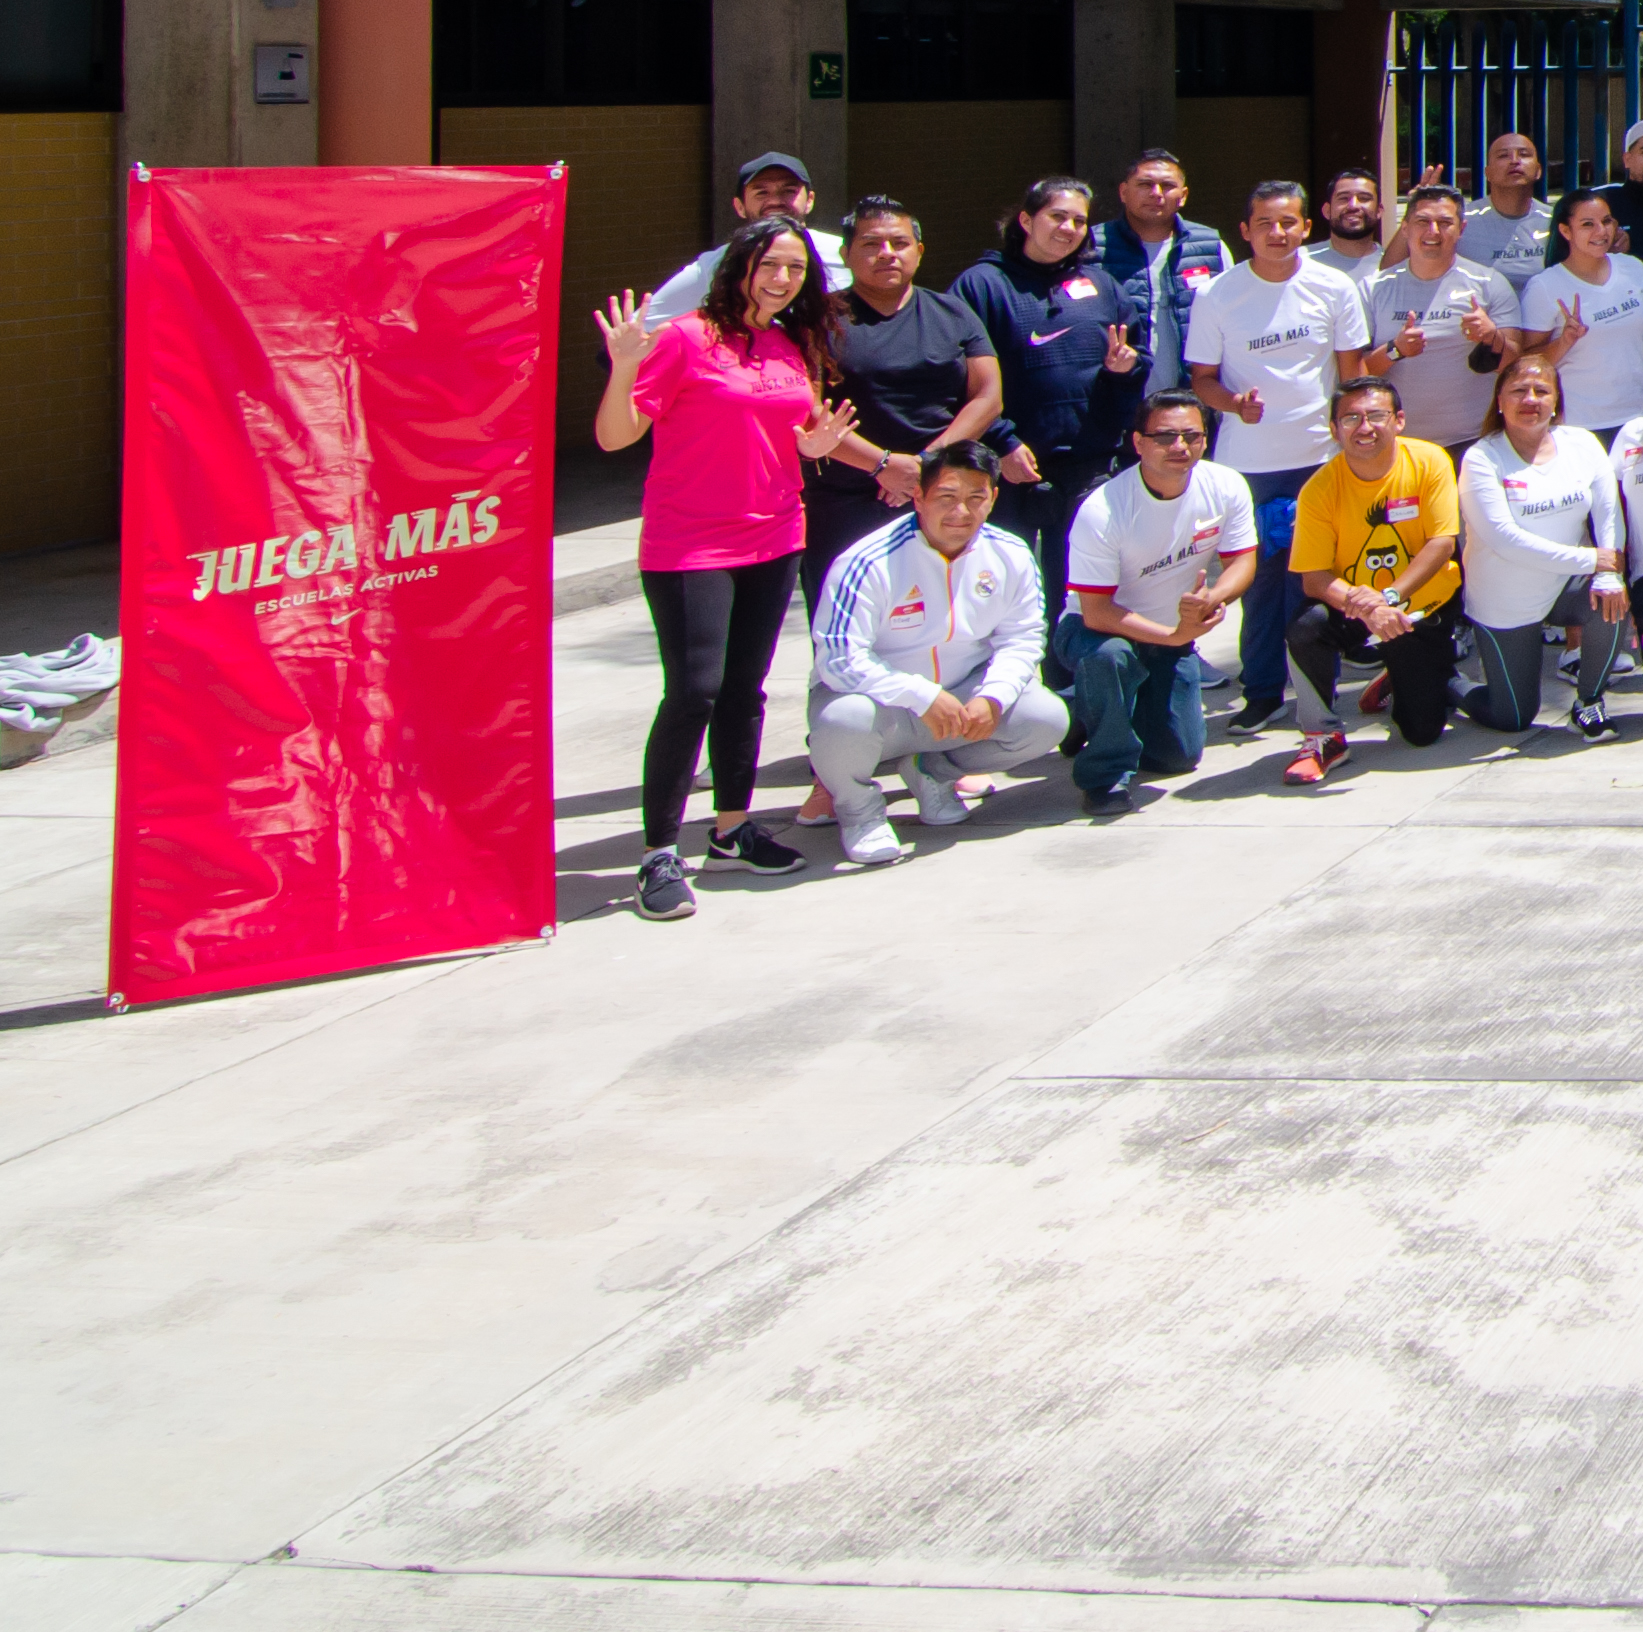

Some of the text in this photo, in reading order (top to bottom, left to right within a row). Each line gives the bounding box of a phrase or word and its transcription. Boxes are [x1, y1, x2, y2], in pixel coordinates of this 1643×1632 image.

[1391, 310, 1423, 321] JUEA
[1247, 332, 1281, 351] JUEGA
[1285, 324, 1310, 341] MÁS
[1521, 499, 1555, 517] JUEGA
[186, 489, 501, 601] JUEGA MÁS
[254, 565, 439, 615] ESCUELAS ACTIVAS
